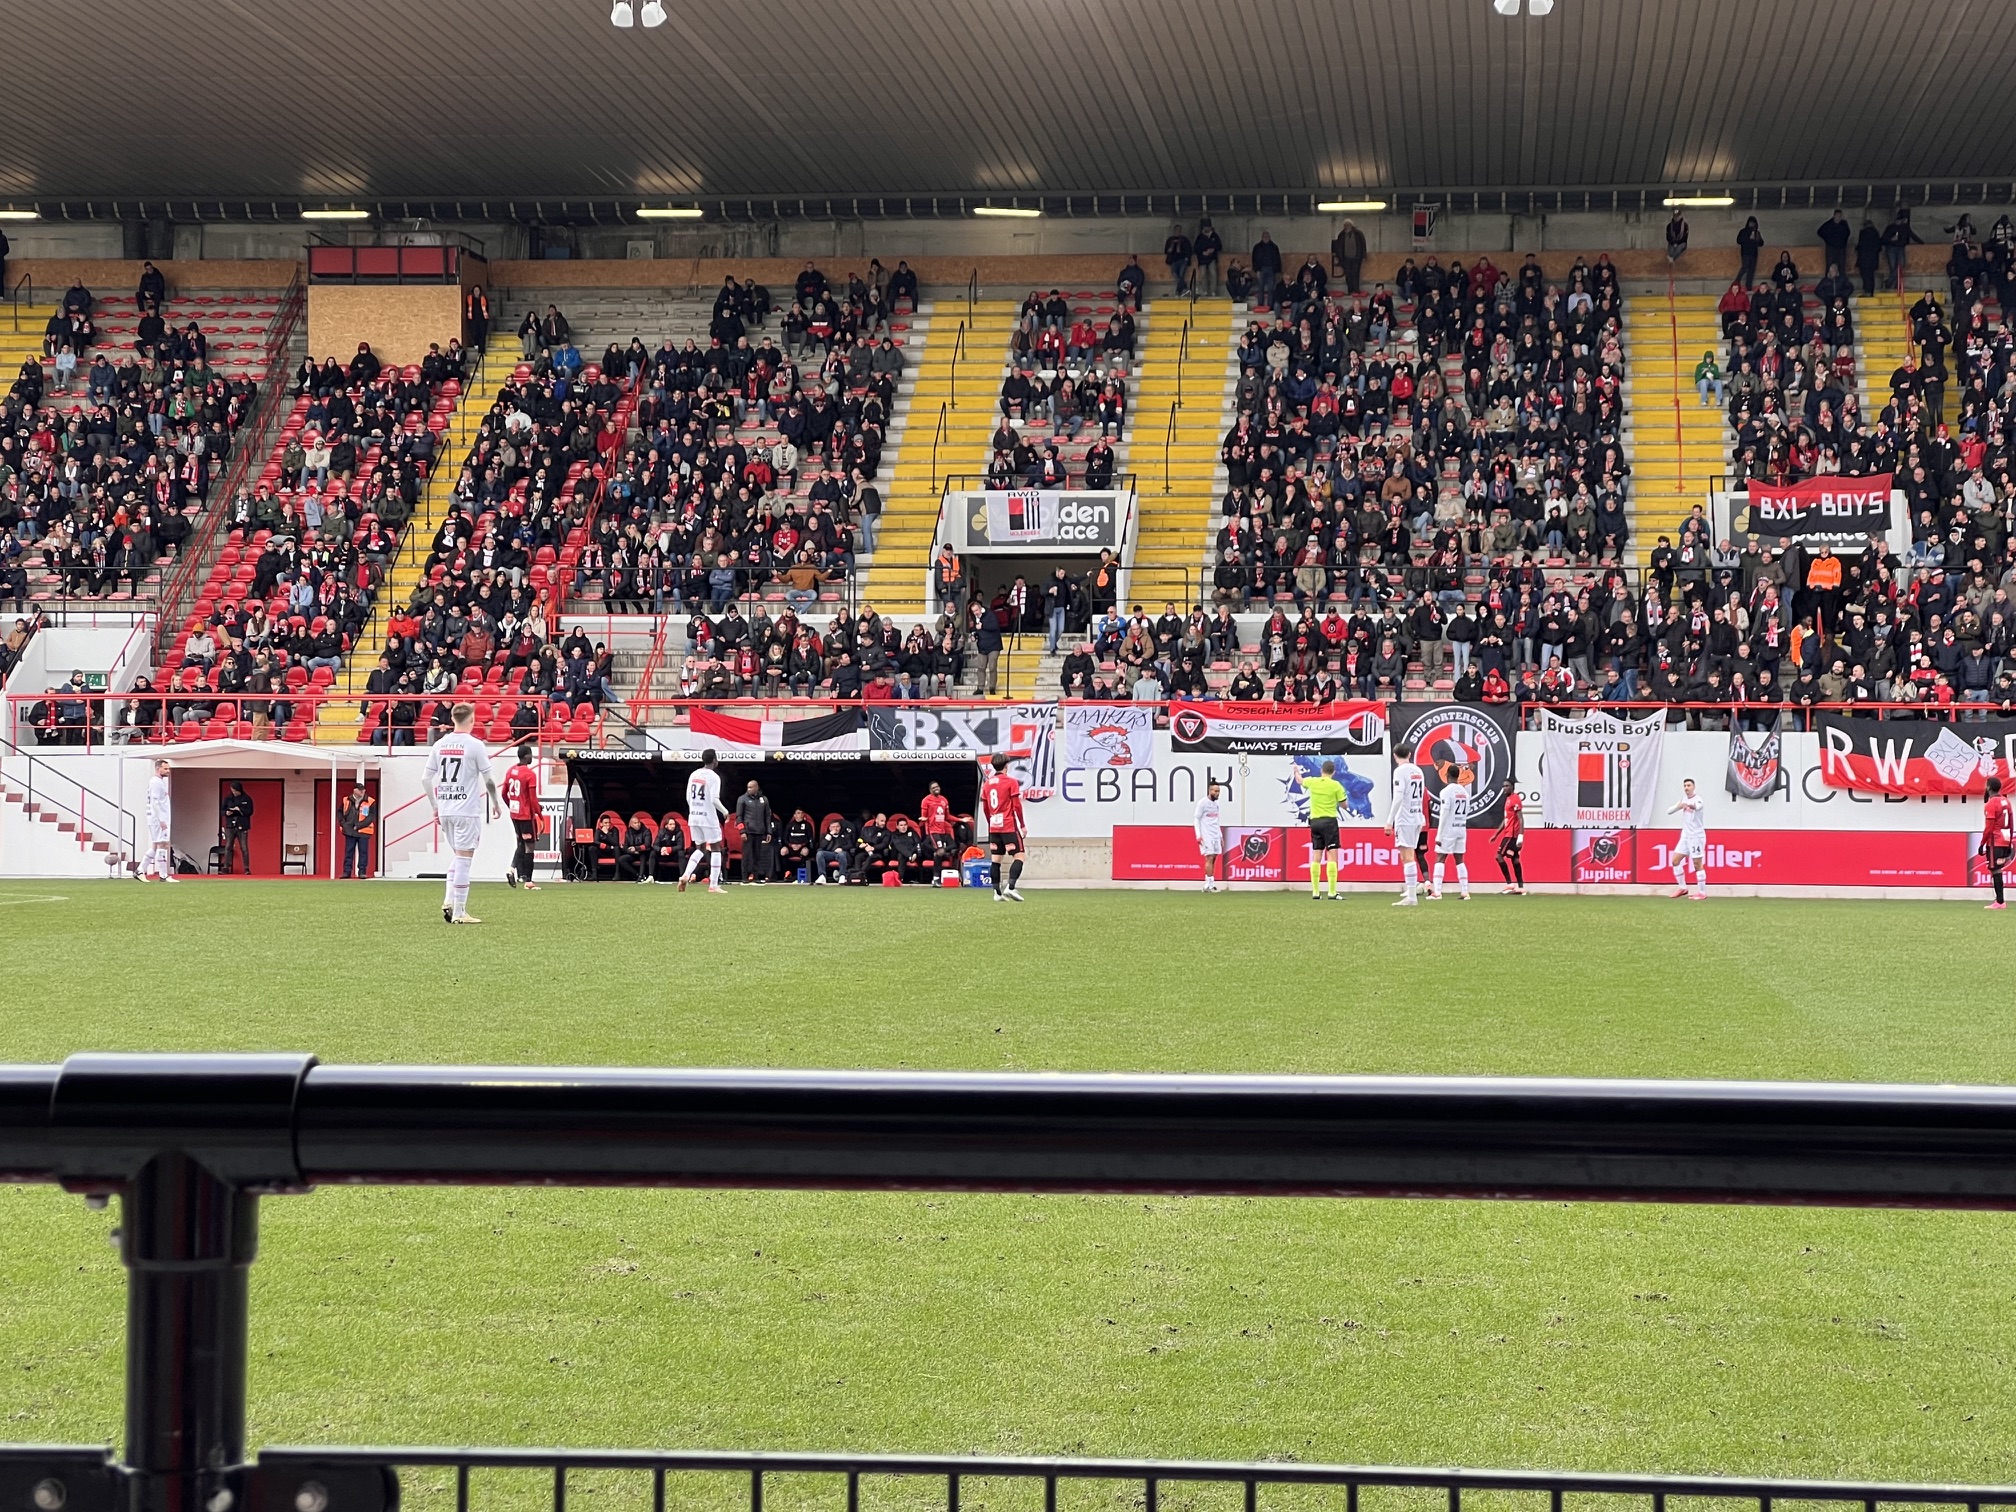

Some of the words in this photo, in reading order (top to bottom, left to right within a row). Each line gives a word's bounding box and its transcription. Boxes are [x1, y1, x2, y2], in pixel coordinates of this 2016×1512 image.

[1227, 706, 1293, 716] OSSEGHEM
[1298, 707, 1325, 716] SIDE
[1218, 723, 1296, 732] SUPPORTERS
[1409, 712, 1500, 744] SUPPORTERSCLUB
[1547, 717, 1616, 734] Brussels
[1622, 720, 1660, 736] Boys
[1228, 742, 1277, 751] ALWAYS
[1283, 742, 1322, 751] THERE
[1578, 741, 1631, 752] RWD
[1929, 740, 1960, 765] BXL
[579, 750, 653, 760] Goldenpalace
[786, 751, 862, 761] Goldenpalace
[893, 751, 967, 760] Goldenpalace
[1942, 746, 1975, 779] BOYS
[441, 757, 462, 783] 17
[508, 778, 521, 797] 29
[989, 788, 998, 809] 8
[1454, 800, 1467, 815] 27
[1577, 809, 1631, 820] MOLENBEEK
[1228, 864, 1281, 881] Jupiler
[1577, 866, 1631, 882] Jupiler
